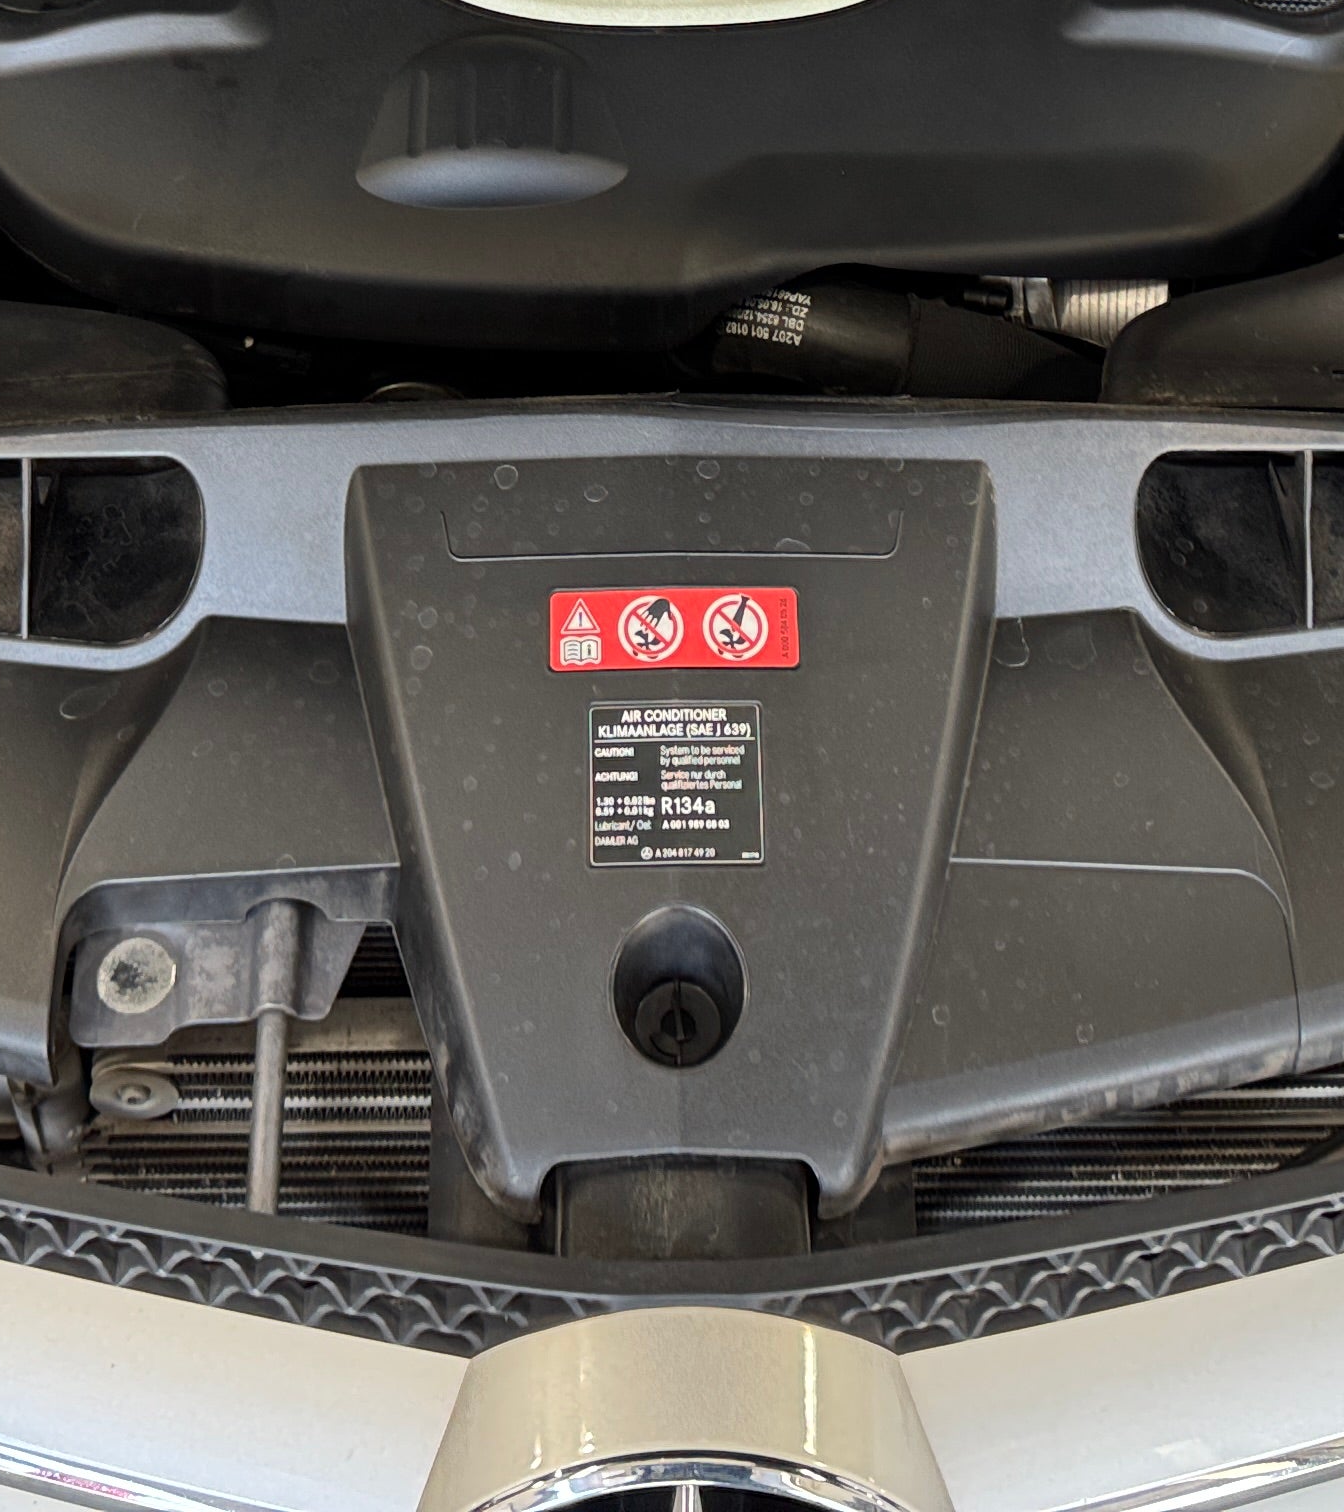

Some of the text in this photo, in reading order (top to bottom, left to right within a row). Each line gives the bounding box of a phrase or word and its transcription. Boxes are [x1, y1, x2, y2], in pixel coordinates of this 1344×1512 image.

[781, 316, 805, 332] DBL
[751, 324, 770, 340] 501
[772, 329, 803, 346] A207
[621, 708, 727, 723] AIR CONDITIONER
[598, 723, 684, 738] KLIMAANLAGE
[686, 723, 713, 738] (SAE
[723, 723, 751, 738] 639)
[660, 744, 745, 757] System to be serviced
[661, 796, 716, 815] R134a
[662, 820, 670, 829] A
[655, 848, 662, 858] A
